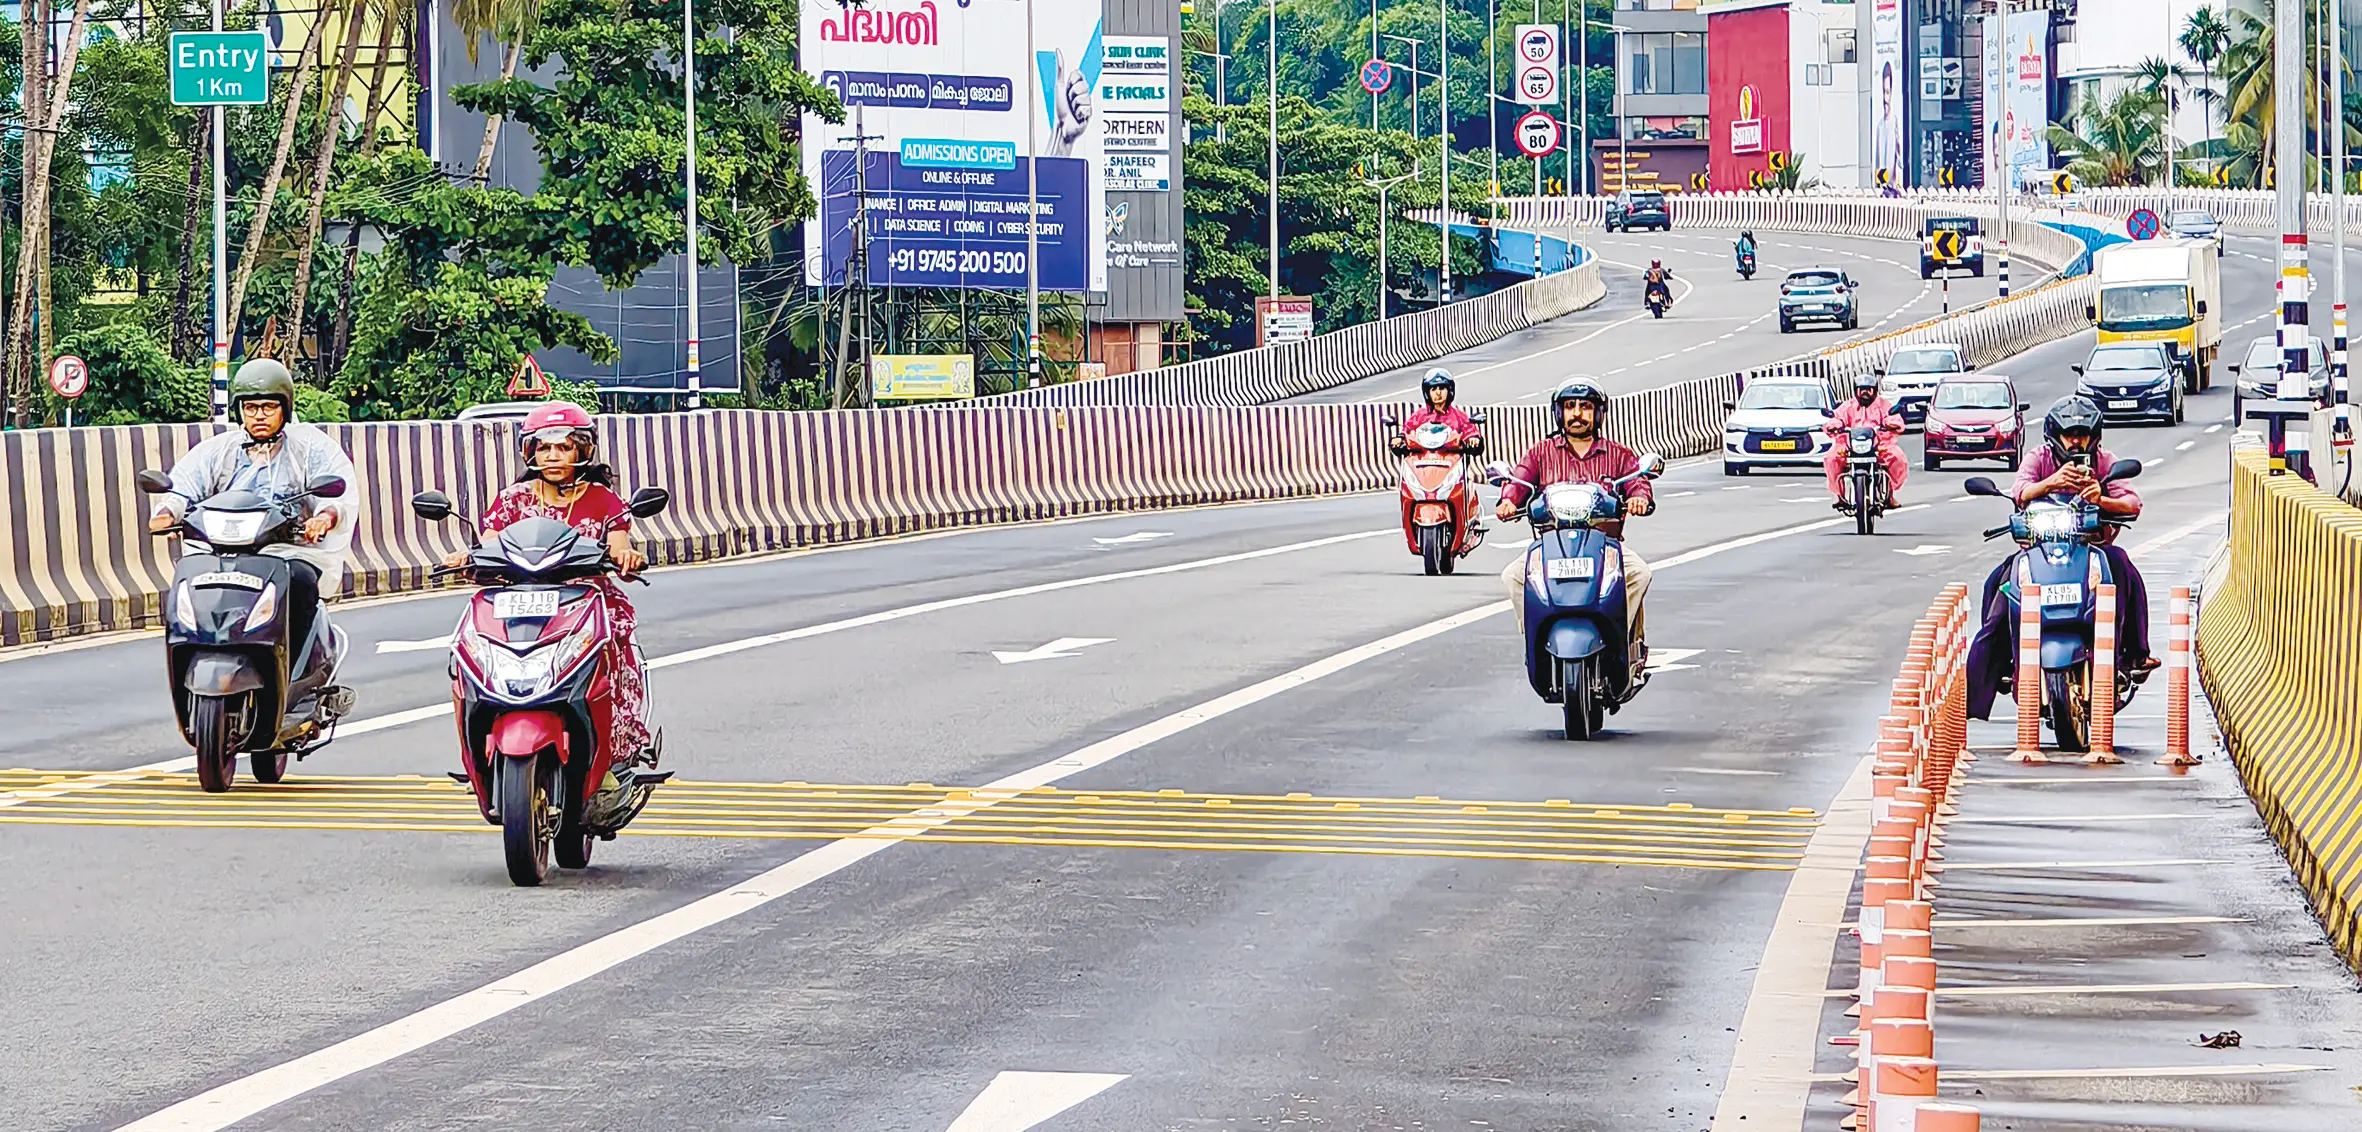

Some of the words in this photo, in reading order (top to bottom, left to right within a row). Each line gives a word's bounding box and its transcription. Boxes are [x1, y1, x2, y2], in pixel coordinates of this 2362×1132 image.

[820, 1, 938, 45] പദ്ധതി
[178, 42, 259, 72] Entry
[1530, 47, 1544, 58] 50
[196, 78, 204, 96] 1
[210, 77, 242, 96] Km
[1116, 86, 1165, 100] FACIALS
[1530, 83, 1544, 94] 65
[1529, 135, 1547, 148] 80
[904, 144, 979, 162] ADMISSIONS
[980, 146, 1013, 163] OPEN
[1110, 156, 1156, 168] SHAFEEQ
[922, 171, 953, 184] ONLINE
[953, 172, 961, 184] &
[961, 172, 995, 185] OFFLINE
[1119, 167, 1142, 178] ANIL
[865, 197, 897, 211] INANCE
[907, 199, 937, 212] OFFICE
[938, 200, 967, 213] ADMIN
[973, 200, 1005, 213] DIGITAL
[1005, 201, 1054, 215] MARKTING
[884, 219, 907, 231] DATA
[906, 219, 942, 232] SCIENCE
[953, 220, 985, 233] CODING
[1025, 222, 1064, 236] SCURITY
[1133, 240, 1179, 253] Network
[887, 248, 915, 272] +91
[918, 249, 957, 272] 9745
[958, 250, 991, 273] 200
[993, 251, 1026, 274] 500
[1128, 254, 1150, 267] Care
